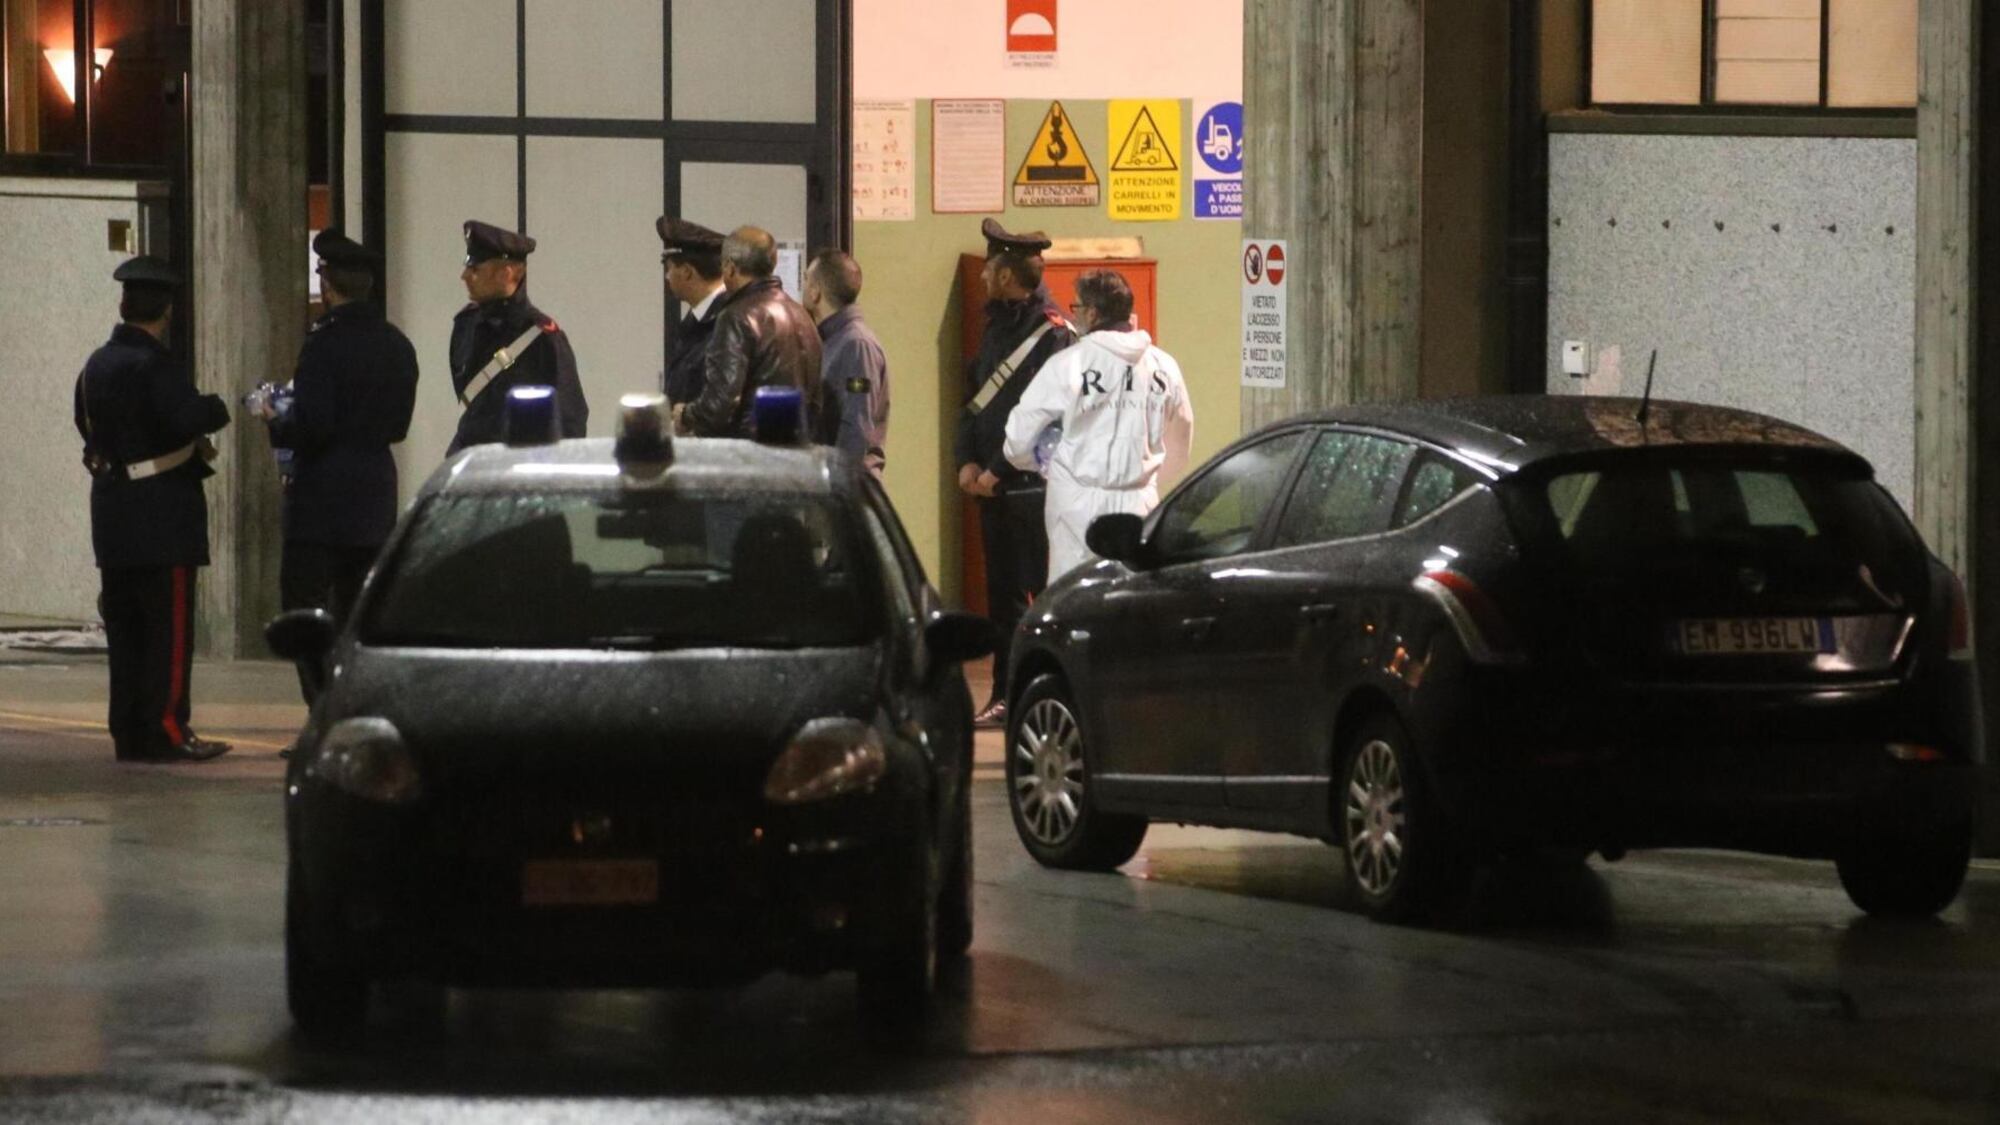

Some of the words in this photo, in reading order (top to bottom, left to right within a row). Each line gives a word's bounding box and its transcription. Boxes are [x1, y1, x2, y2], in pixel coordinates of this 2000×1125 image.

[1113, 177, 1175, 187] ATTENZIONE
[1212, 182, 1242, 193] VEICOL
[1023, 184, 1086, 196] ATTENZIONE
[1113, 191, 1162, 200] CARRELLI
[1165, 191, 1176, 200] IN
[1208, 194, 1216, 203] A
[1218, 193, 1242, 204] PASS
[1116, 204, 1173, 214] MOVIMENTO
[1210, 204, 1242, 214] D'UOM
[1251, 295, 1277, 309] VIETATO
[1247, 312, 1280, 327] L'ACCESSO
[1253, 330, 1282, 345] PERSONE
[1242, 347, 1248, 360] E
[1249, 348, 1269, 361] MEZZI
[1271, 349, 1285, 362] NON
[1244, 365, 1284, 380] AUTORIZZATI
[1684, 620, 1720, 650] EM
